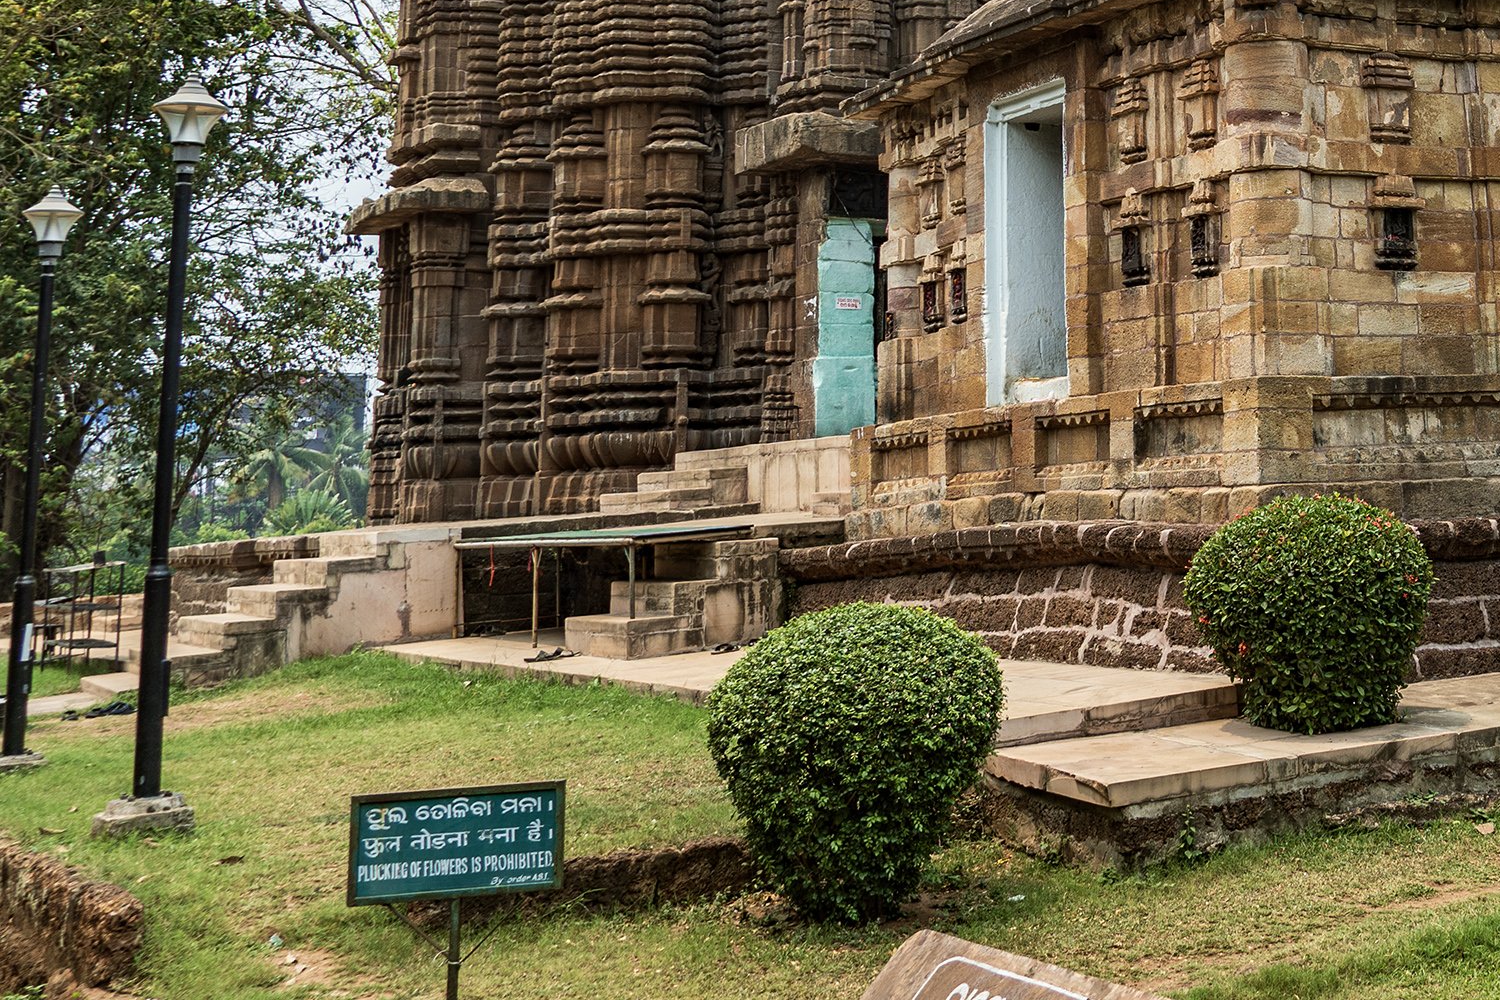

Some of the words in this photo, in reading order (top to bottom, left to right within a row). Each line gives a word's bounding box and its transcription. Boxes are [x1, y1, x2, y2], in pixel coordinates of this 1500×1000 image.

[477, 826, 520, 844] मना
[410, 861, 422, 878] OF
[423, 857, 468, 877] FLOWERS
[471, 856, 482, 873] IS
[484, 850, 555, 871] PROHIBITED.
[490, 876, 504, 886] By
